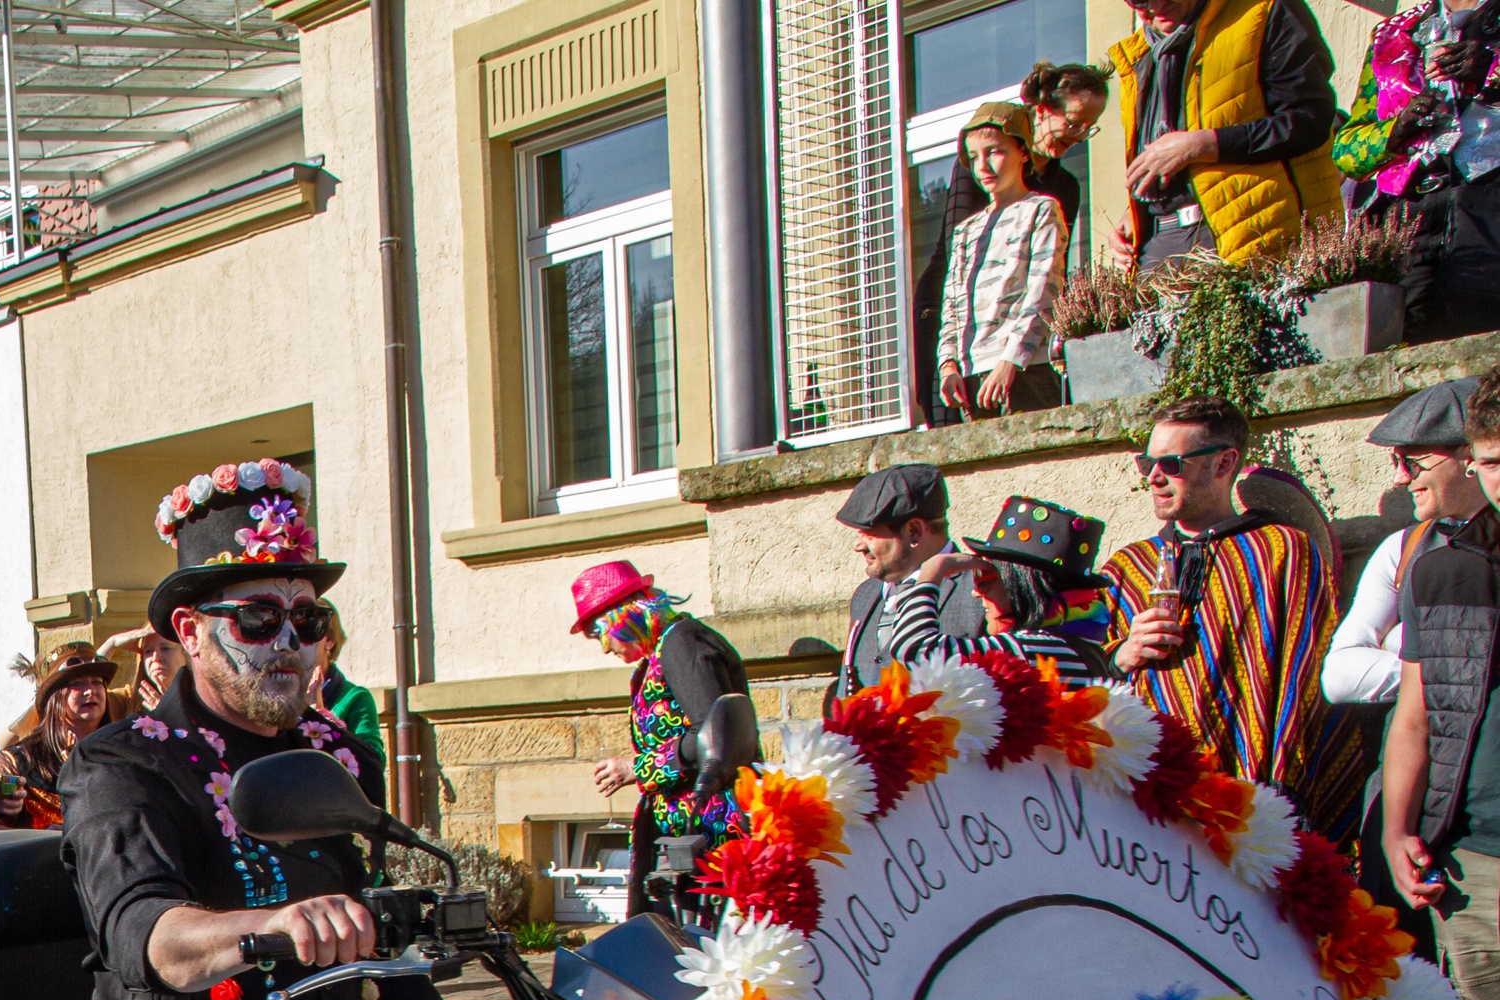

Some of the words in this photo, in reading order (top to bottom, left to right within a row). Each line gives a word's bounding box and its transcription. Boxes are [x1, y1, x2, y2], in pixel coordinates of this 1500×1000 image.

[873, 818, 946, 921] de
[924, 780, 1013, 874] los
[1022, 763, 1261, 960] Muertos
